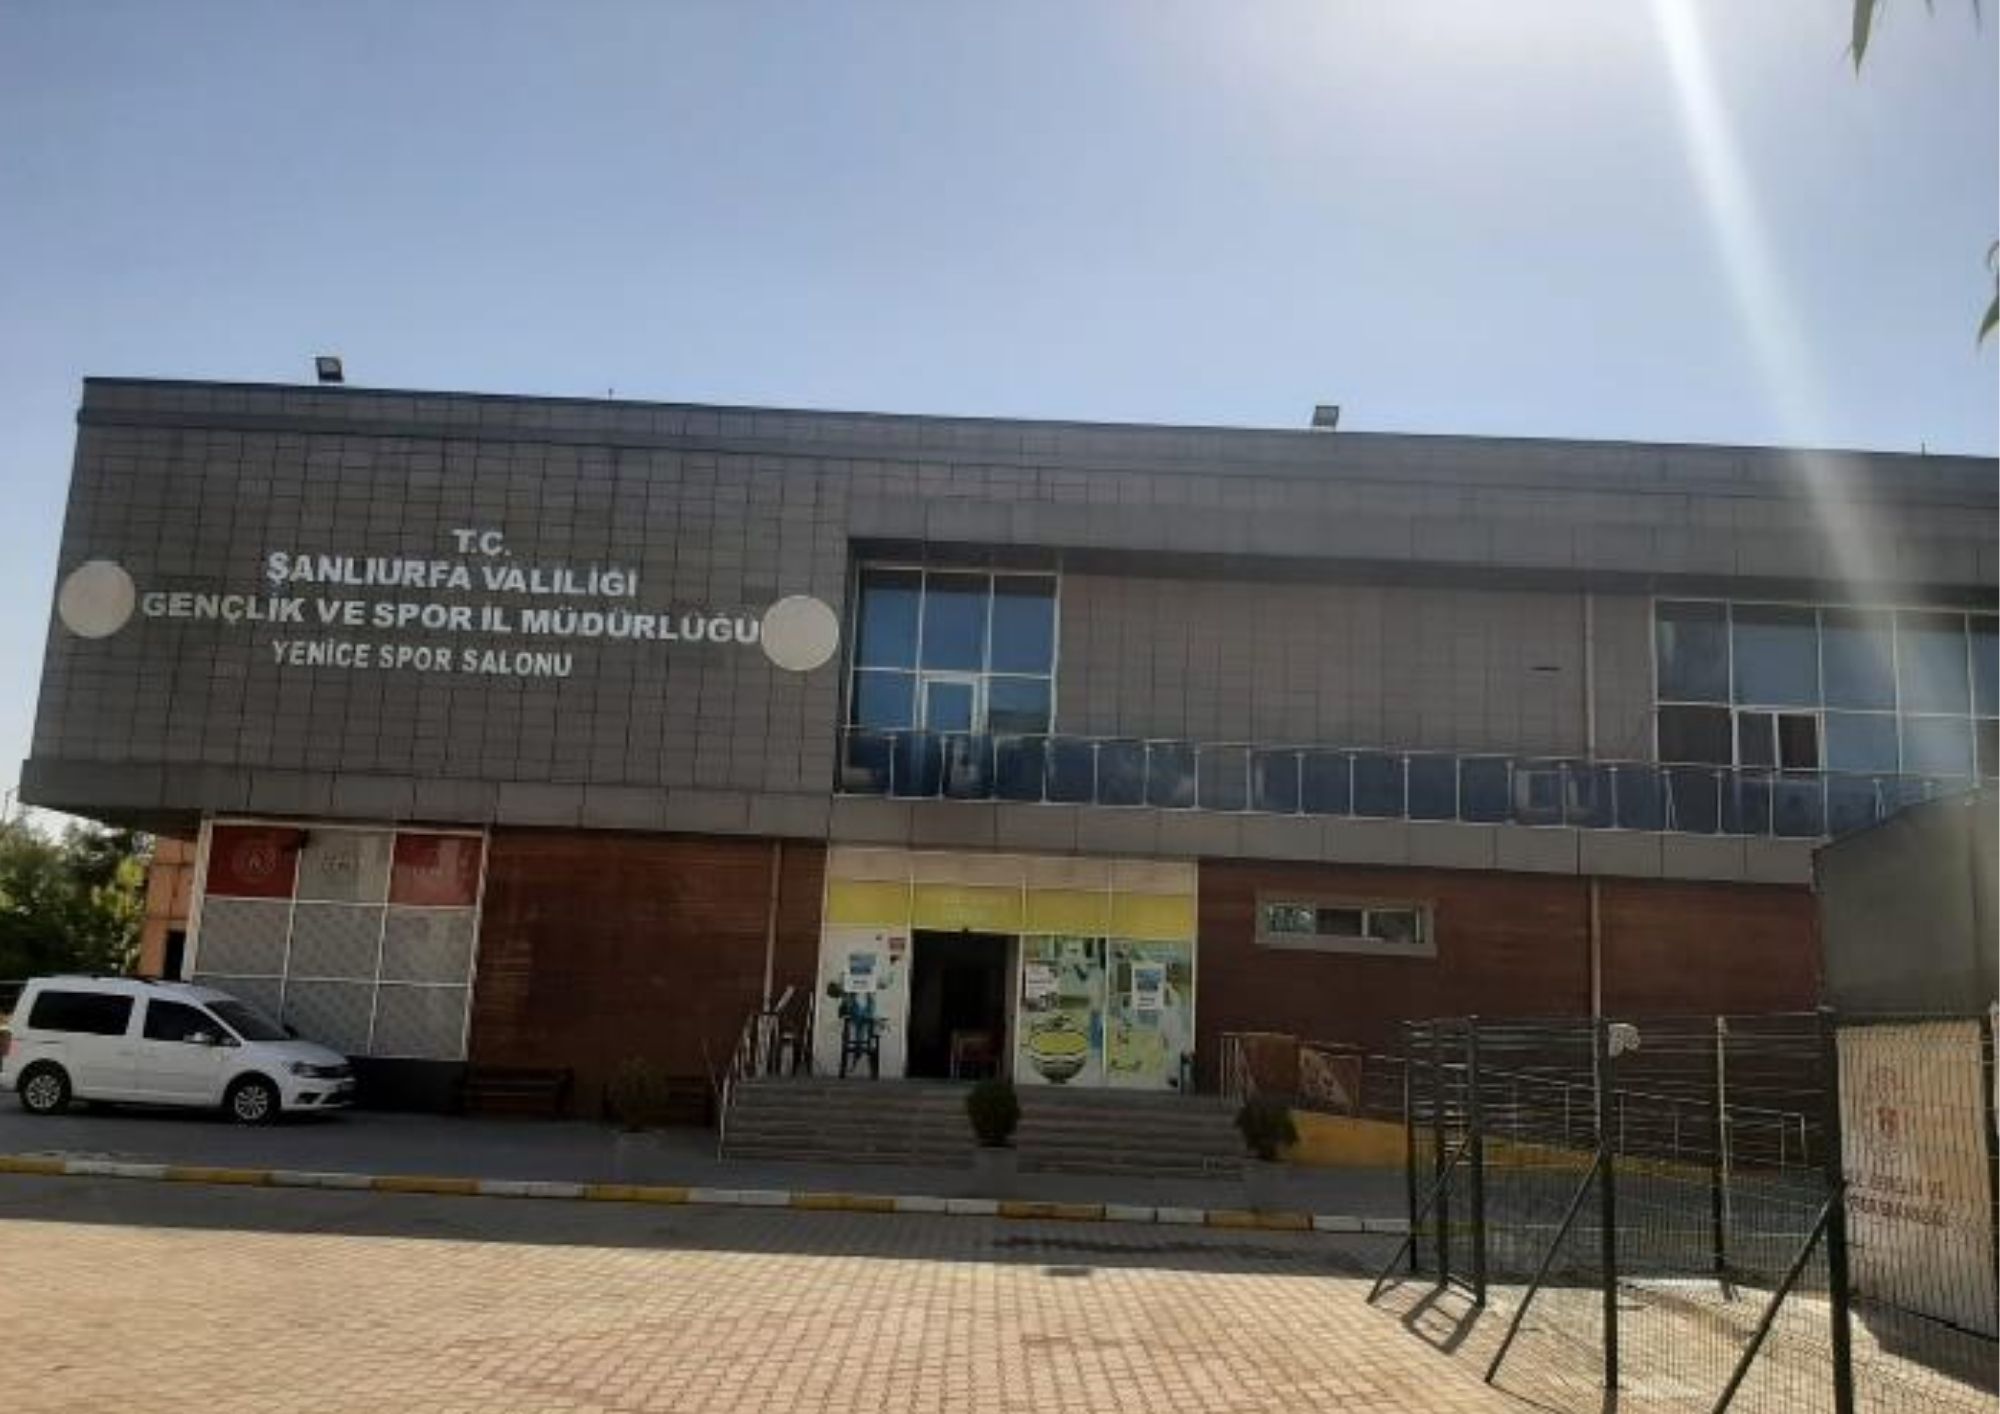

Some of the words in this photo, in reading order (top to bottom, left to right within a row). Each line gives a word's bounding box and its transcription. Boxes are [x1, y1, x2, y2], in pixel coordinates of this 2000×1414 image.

[452, 528, 511, 556] T.C.
[266, 551, 471, 590] ŞANLIURFA
[142, 590, 304, 624] GENÇLİK
[317, 599, 365, 625] VE
[372, 603, 471, 631] SPOR
[272, 638, 369, 668] YENİCE
[378, 644, 451, 672] SPOR
[462, 649, 572, 677] SALONU
